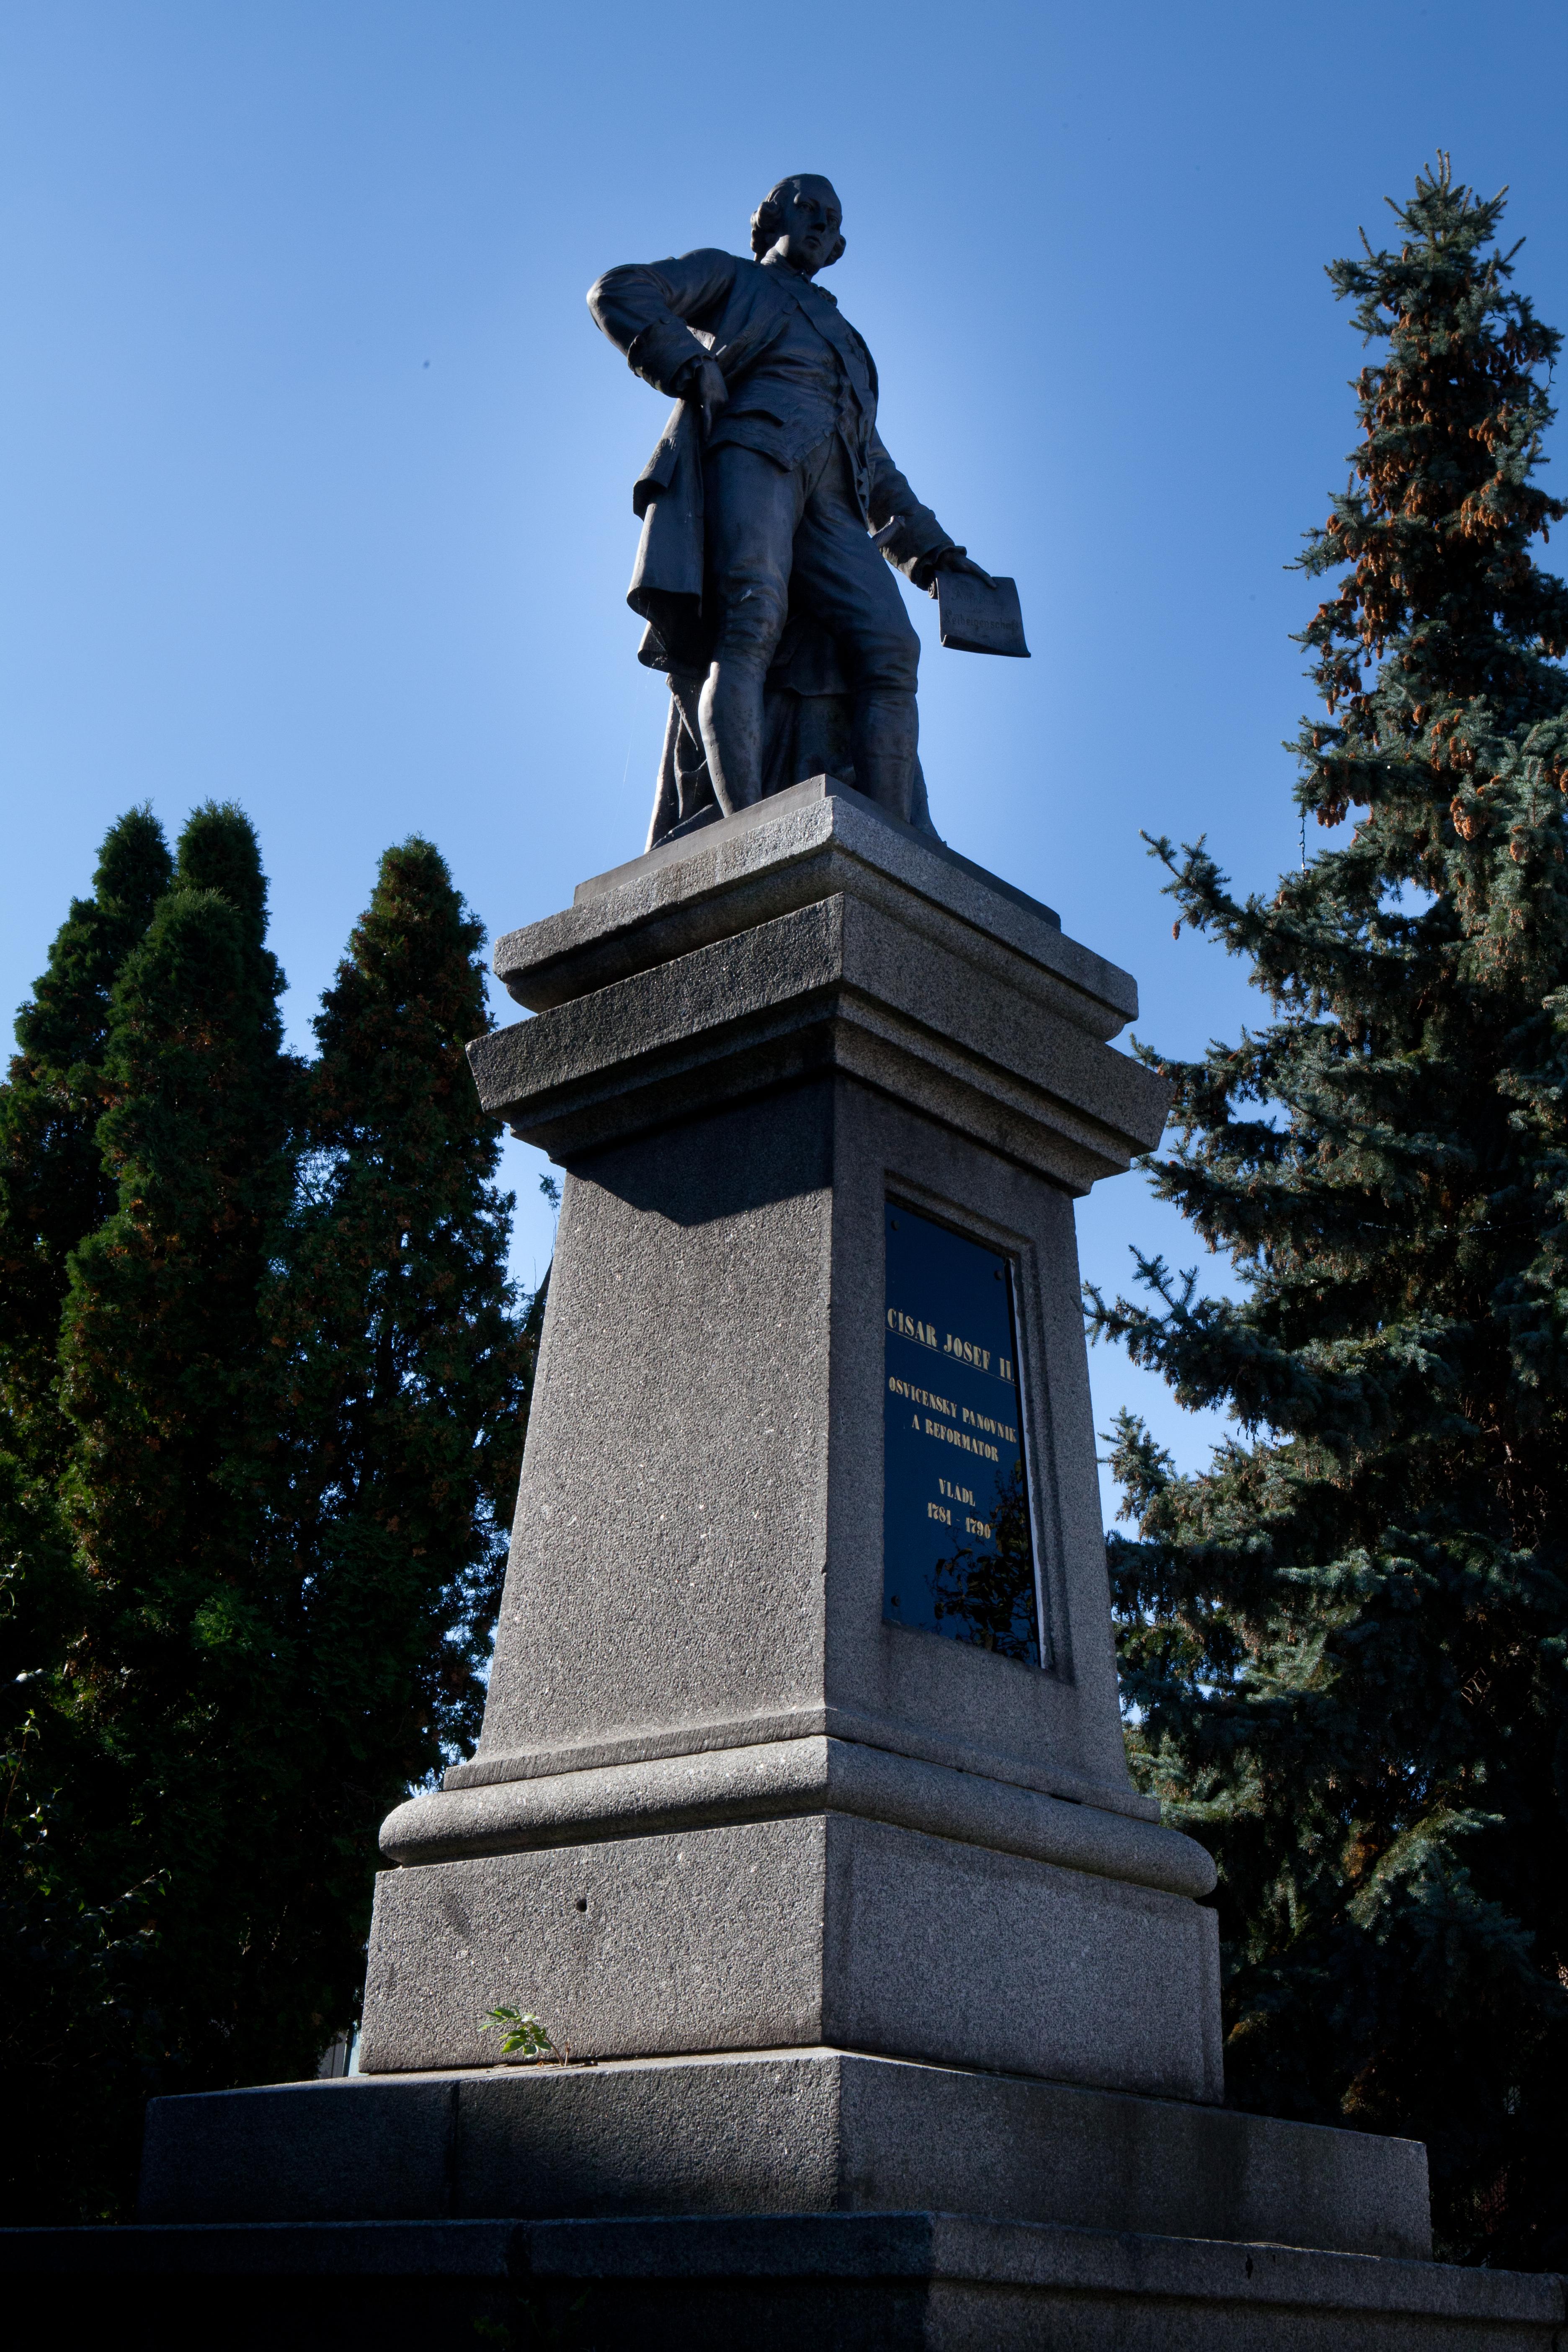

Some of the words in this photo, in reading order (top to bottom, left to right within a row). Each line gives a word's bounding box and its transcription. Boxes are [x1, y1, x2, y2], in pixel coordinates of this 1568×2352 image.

[943, 1333, 990, 1370] JOSEF
[999, 1357, 1015, 1382] II.
[911, 1414, 920, 1430] A
[938, 1478, 975, 1507] VLÁDL
[927, 1502, 952, 1526] 1781
[965, 1517, 991, 1539] 1790
